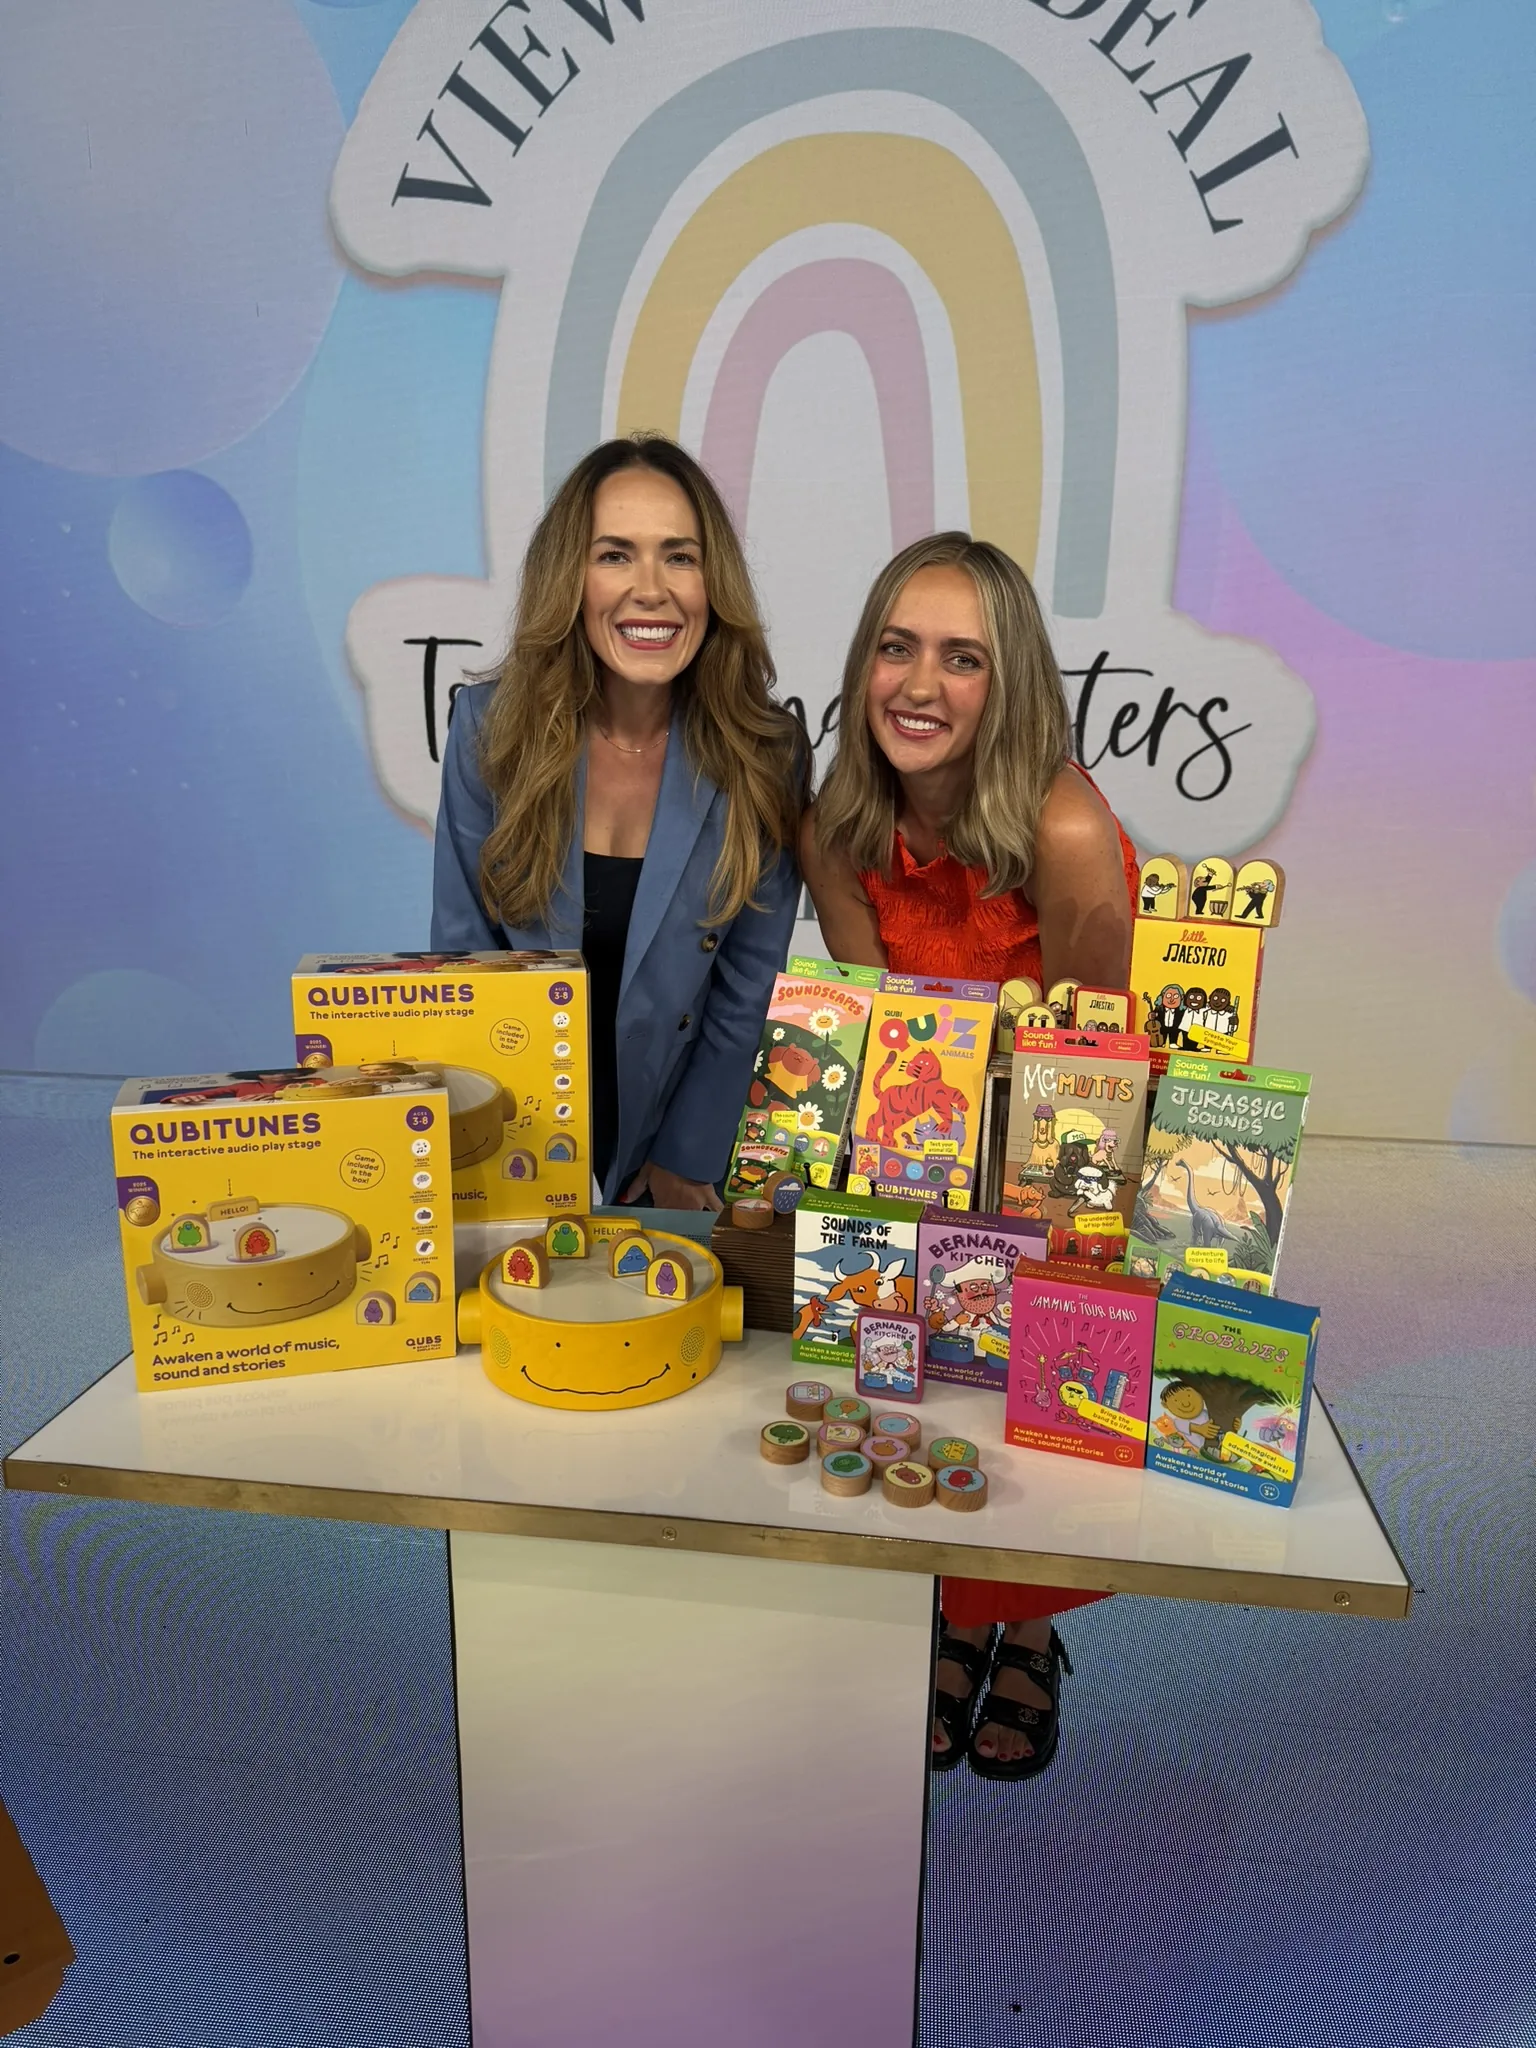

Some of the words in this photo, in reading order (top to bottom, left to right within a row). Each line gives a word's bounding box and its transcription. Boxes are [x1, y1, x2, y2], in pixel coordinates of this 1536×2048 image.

[1028, 0, 1299, 234] EAL
[1179, 929, 1208, 944] little
[794, 959, 817, 969] Sounds
[804, 968, 818, 976] fun!
[886, 976, 914, 985] Sounds
[308, 984, 474, 1006] QUBITUNES
[554, 992, 568, 1000] 3-8
[900, 985, 916, 993] fun!
[778, 985, 864, 1015] SOUNDSCAPES
[310, 1011, 328, 1020] The
[331, 1009, 390, 1019] interactive
[392, 1009, 420, 1018] audio
[423, 1008, 442, 1018] play
[445, 1008, 474, 1017] stage
[1023, 1031, 1054, 1040] Sounds
[1039, 1040, 1057, 1048] fun!
[941, 1050, 974, 1059] ANIMALS
[1176, 1060, 1208, 1071] Sounds
[1173, 1069, 1189, 1077] like
[1191, 1070, 1211, 1080] fun!
[1171, 1085, 1285, 1120] JURASSIC
[130, 1112, 321, 1145] QUBITUNES
[413, 1116, 428, 1126] 3-8
[1187, 1107, 1264, 1136] SOUNDS
[133, 1150, 154, 1160] The
[157, 1146, 225, 1158] interactive
[227, 1144, 259, 1156] audio
[262, 1142, 285, 1153] play
[288, 1140, 321, 1150] stage
[347, 1160, 379, 1171] included
[545, 1193, 577, 1202] QUBS
[876, 1184, 938, 1199] QUBITUNES
[220, 1205, 249, 1216] HELLO!
[821, 1216, 872, 1235] SOUNDS
[877, 1226, 892, 1237] OF
[820, 1233, 846, 1246] THE
[852, 1236, 888, 1250] FARM
[950, 1251, 1014, 1269] KITCHEN
[1030, 1295, 1076, 1313] JAMMING
[1079, 1302, 1106, 1318] TOUR
[1109, 1306, 1138, 1322] BAND
[863, 1321, 916, 1341] BERNARD'S
[874, 1331, 906, 1340] KITCHEN
[1223, 1325, 1242, 1335] THE
[406, 1335, 442, 1346] QUBS
[152, 1352, 212, 1366] Awaken
[216, 1350, 223, 1360] a
[227, 1343, 270, 1358] world
[273, 1341, 292, 1353] of
[294, 1337, 340, 1351] music,
[153, 1366, 200, 1381] sound
[203, 1363, 230, 1376] and
[232, 1358, 286, 1373] stories
[954, 1368, 973, 1376] world
[979, 1378, 1003, 1386] stories
[1093, 1413, 1110, 1423] band
[1100, 1408, 1117, 1420] Bring
[1118, 1416, 1130, 1424] the
[1014, 1427, 1045, 1438] Awaken
[1050, 1435, 1072, 1444] world
[1014, 1434, 1036, 1445] music,
[1038, 1439, 1060, 1448] sound
[1077, 1446, 1104, 1457] stories
[1228, 1442, 1262, 1462] adventure
[1264, 1461, 1289, 1474] awaits!
[1251, 1446, 1277, 1462] magical
[1155, 1453, 1185, 1467] Awaken
[1192, 1464, 1215, 1476] world
[1155, 1460, 1179, 1473] music,
[1180, 1468, 1203, 1479] sound
[1205, 1475, 1219, 1483] and
[1220, 1478, 1248, 1492] stories
